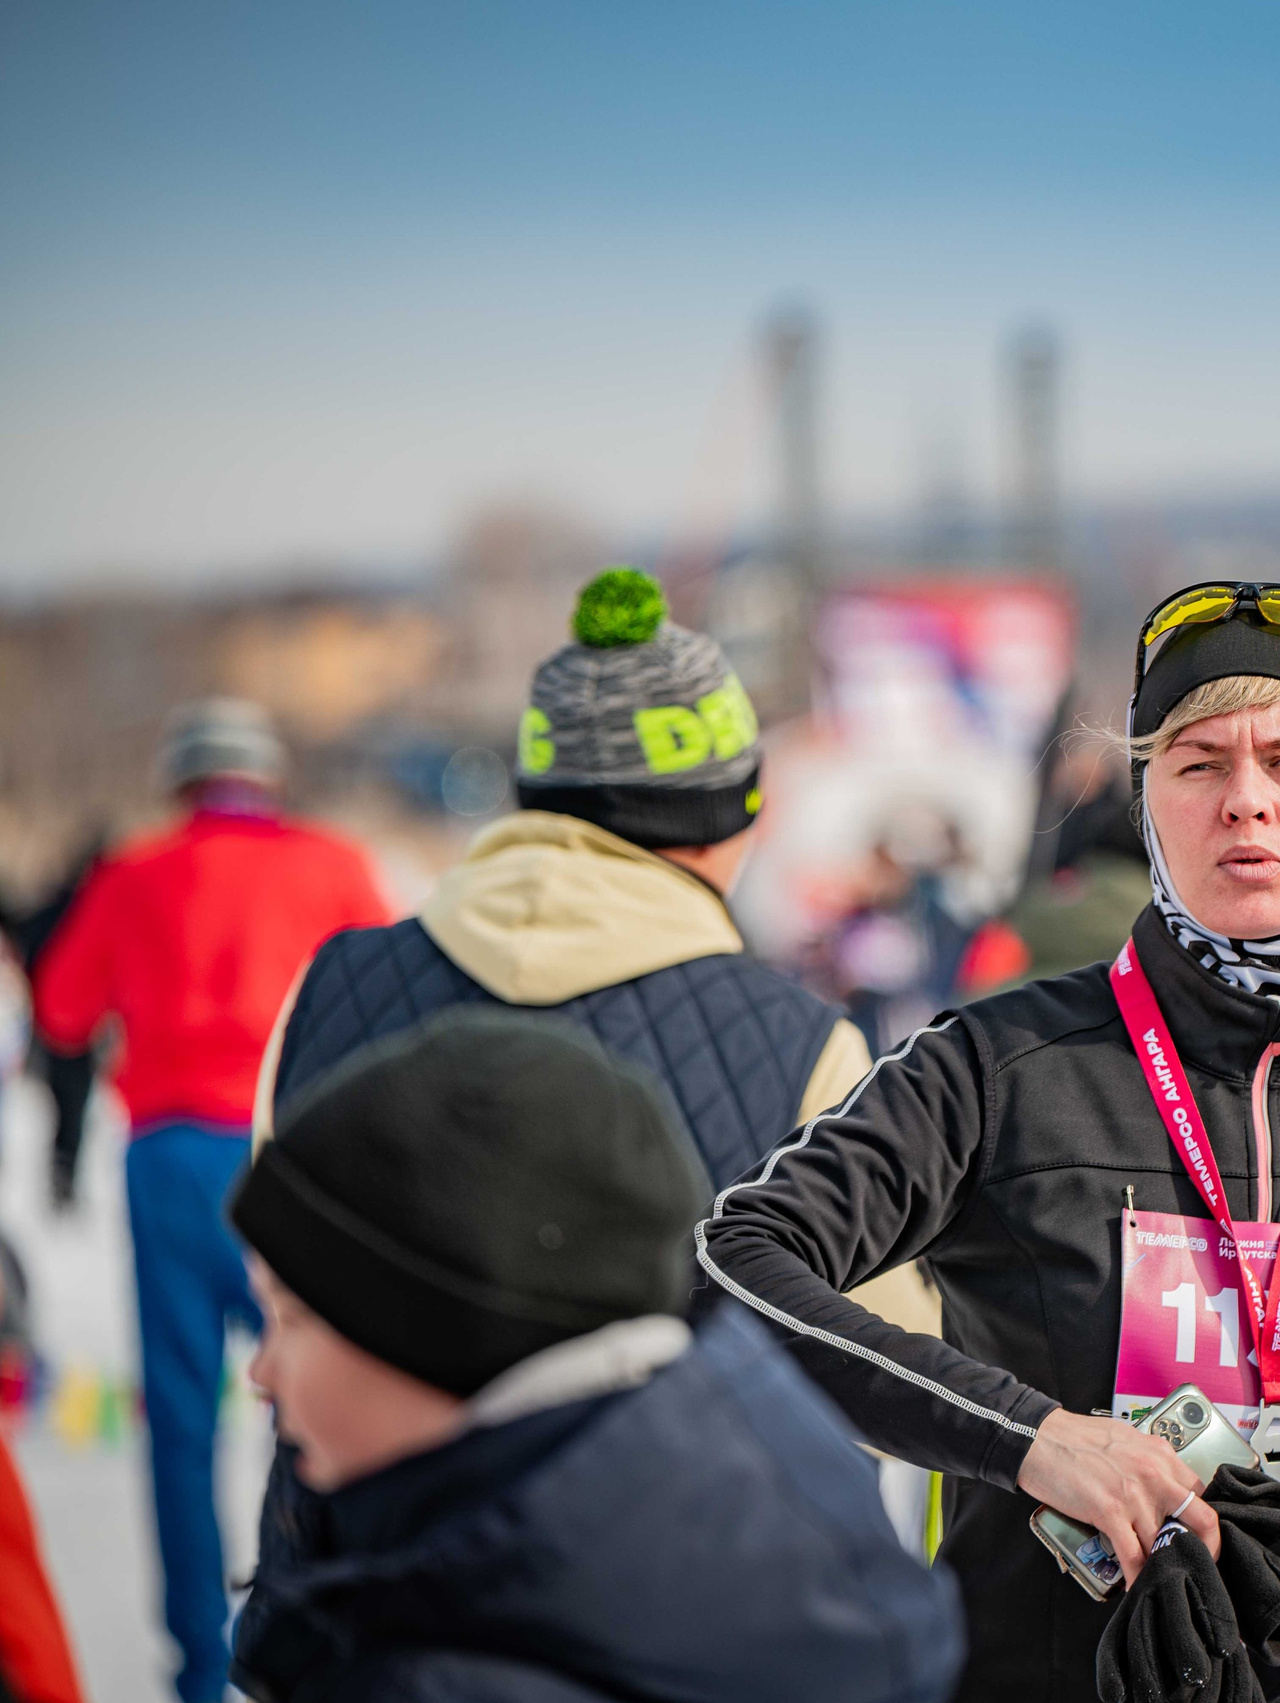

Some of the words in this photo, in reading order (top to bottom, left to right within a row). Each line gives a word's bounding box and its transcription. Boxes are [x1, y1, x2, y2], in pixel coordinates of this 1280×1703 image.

[1142, 1028, 1180, 1102] АНГАРА
[1172, 1107, 1217, 1207] ТЕМЕРСО
[1136, 1231, 1208, 1252] ТЕМЕРСО
[1219, 1247, 1277, 1260] Ирутска
